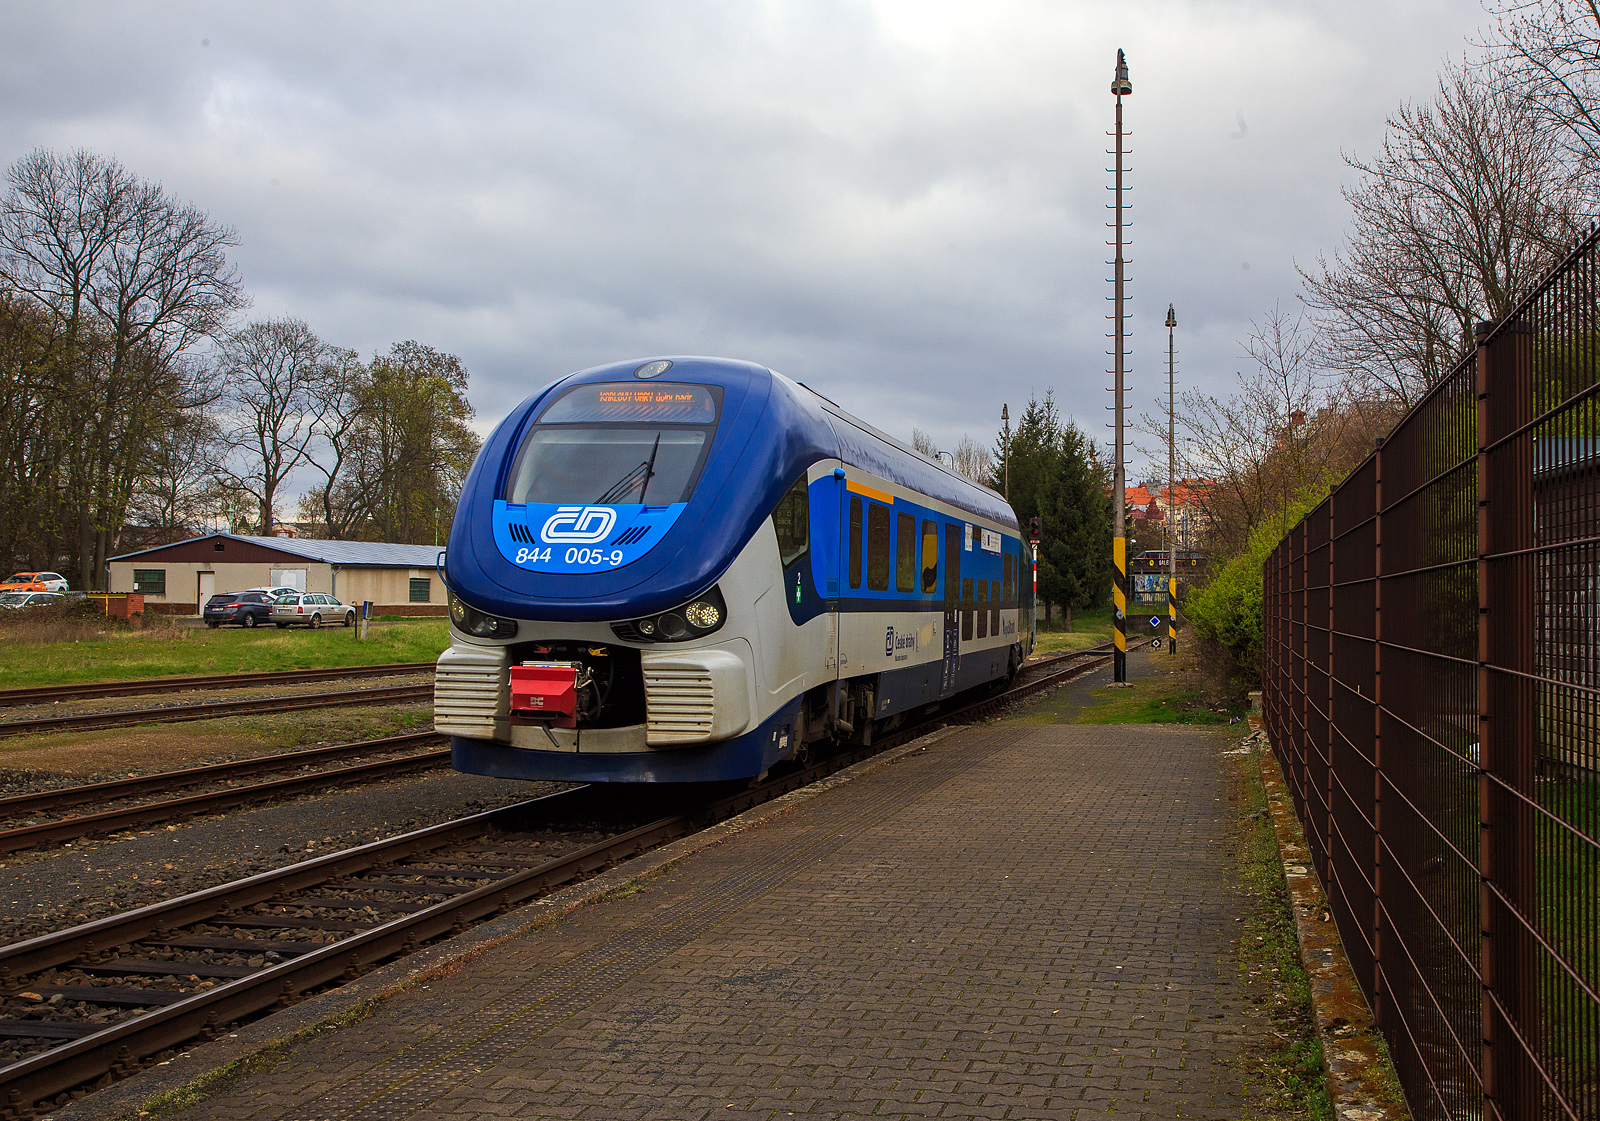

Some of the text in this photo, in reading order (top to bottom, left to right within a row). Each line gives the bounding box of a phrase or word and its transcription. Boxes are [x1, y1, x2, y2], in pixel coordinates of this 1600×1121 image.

[515, 547, 623, 566] 844 005-9
[797, 572, 801, 585] 2
